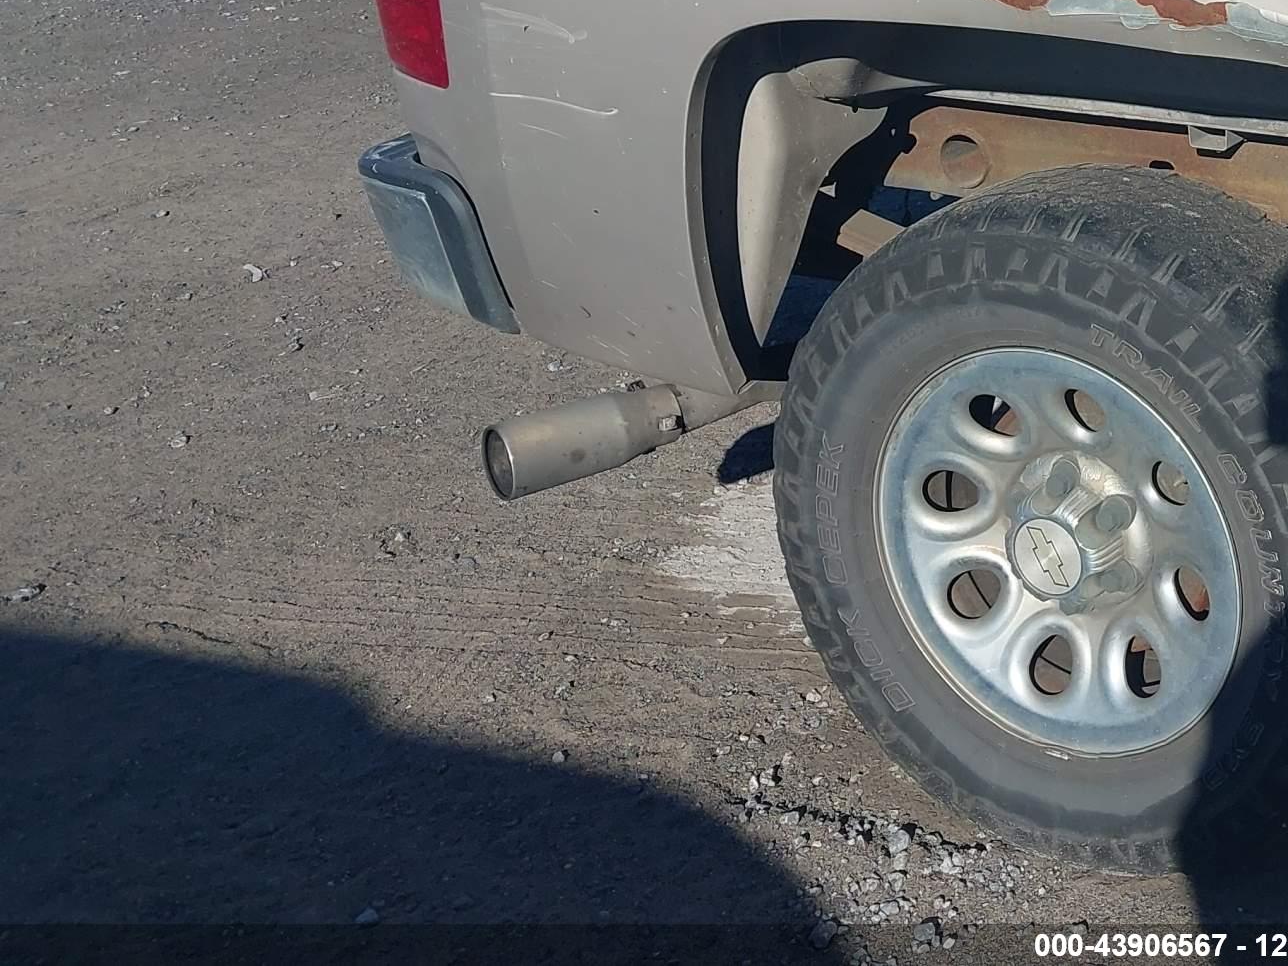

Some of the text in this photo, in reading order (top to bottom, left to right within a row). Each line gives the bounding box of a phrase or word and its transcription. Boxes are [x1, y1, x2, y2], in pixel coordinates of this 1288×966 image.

[1089, 322, 1202, 434] TRAIL
[814, 429, 918, 714] DICK CEPEK
